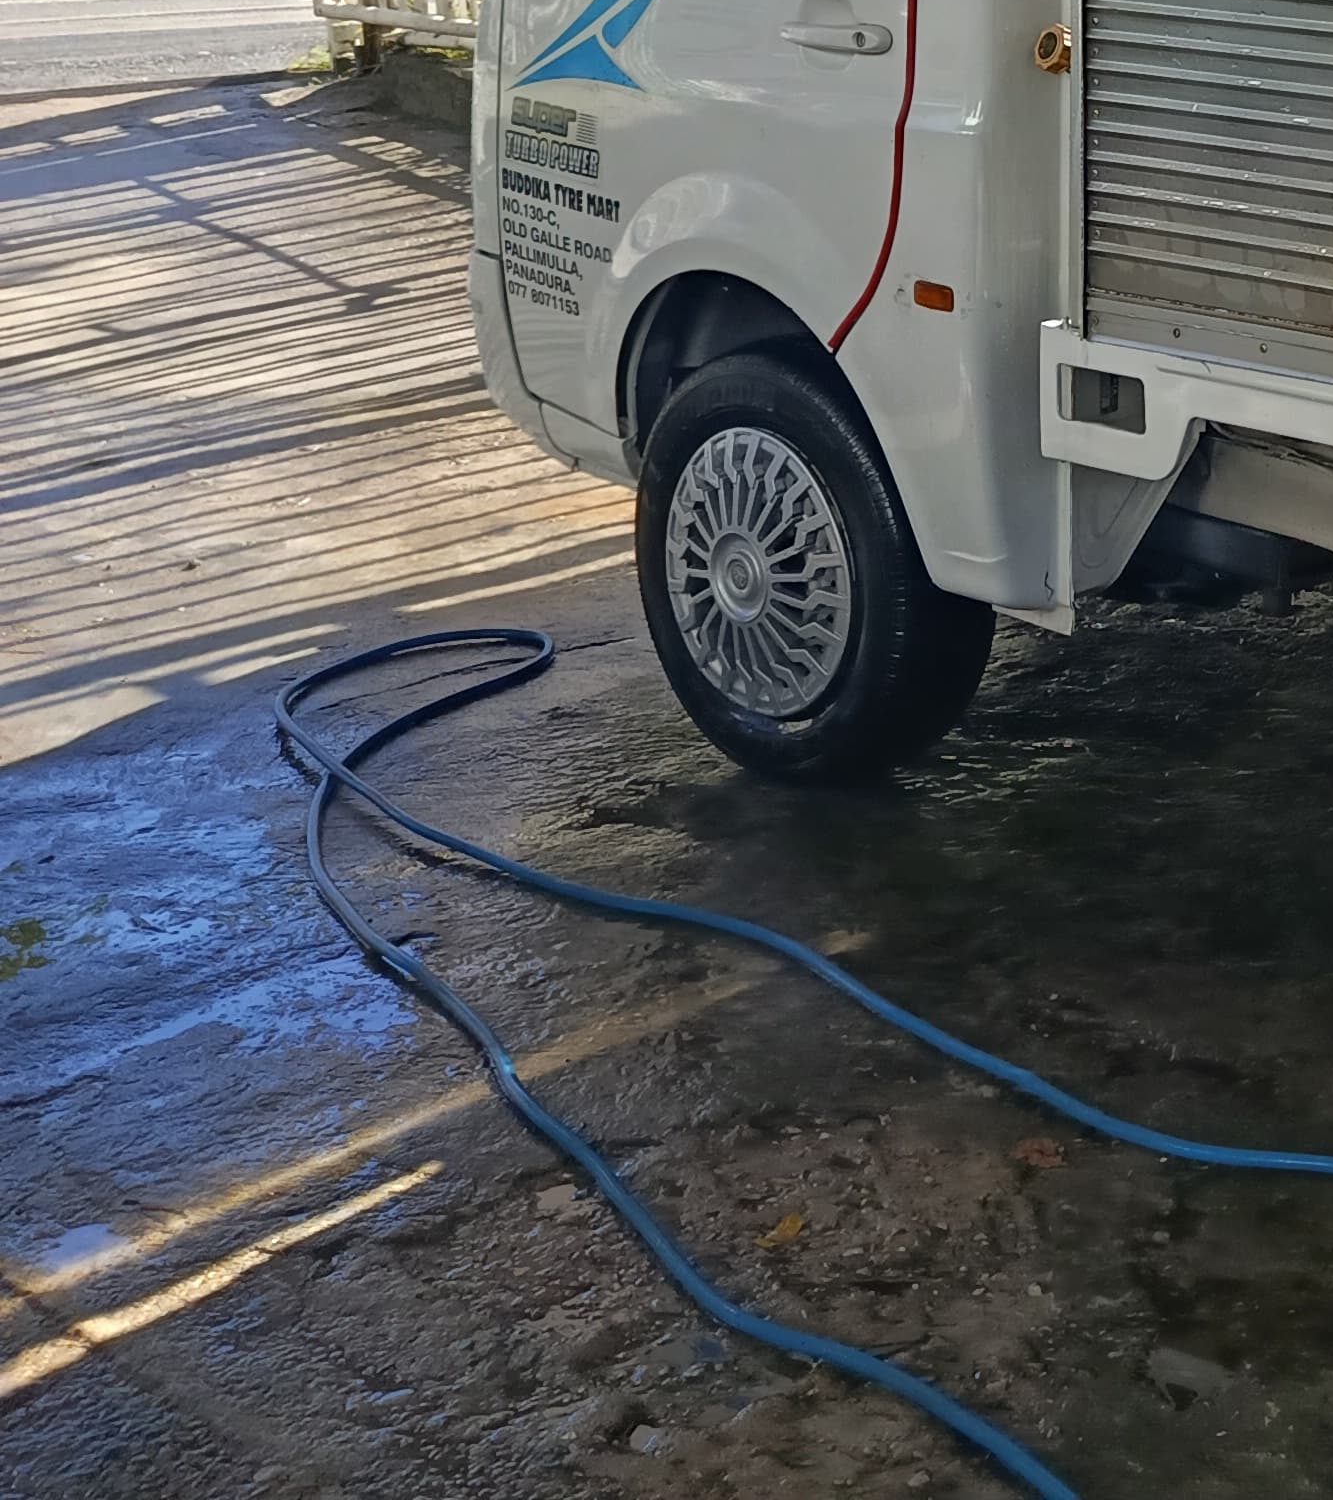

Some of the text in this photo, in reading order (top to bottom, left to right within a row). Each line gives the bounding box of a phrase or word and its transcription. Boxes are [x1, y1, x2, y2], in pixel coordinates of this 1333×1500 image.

[505, 129, 600, 180] TURBO POWER
[502, 167, 620, 223] BUDDIKA TYRE MART
[502, 218, 527, 239] OLD
[530, 227, 572, 253] GALLE
[508, 280, 528, 298] 077
